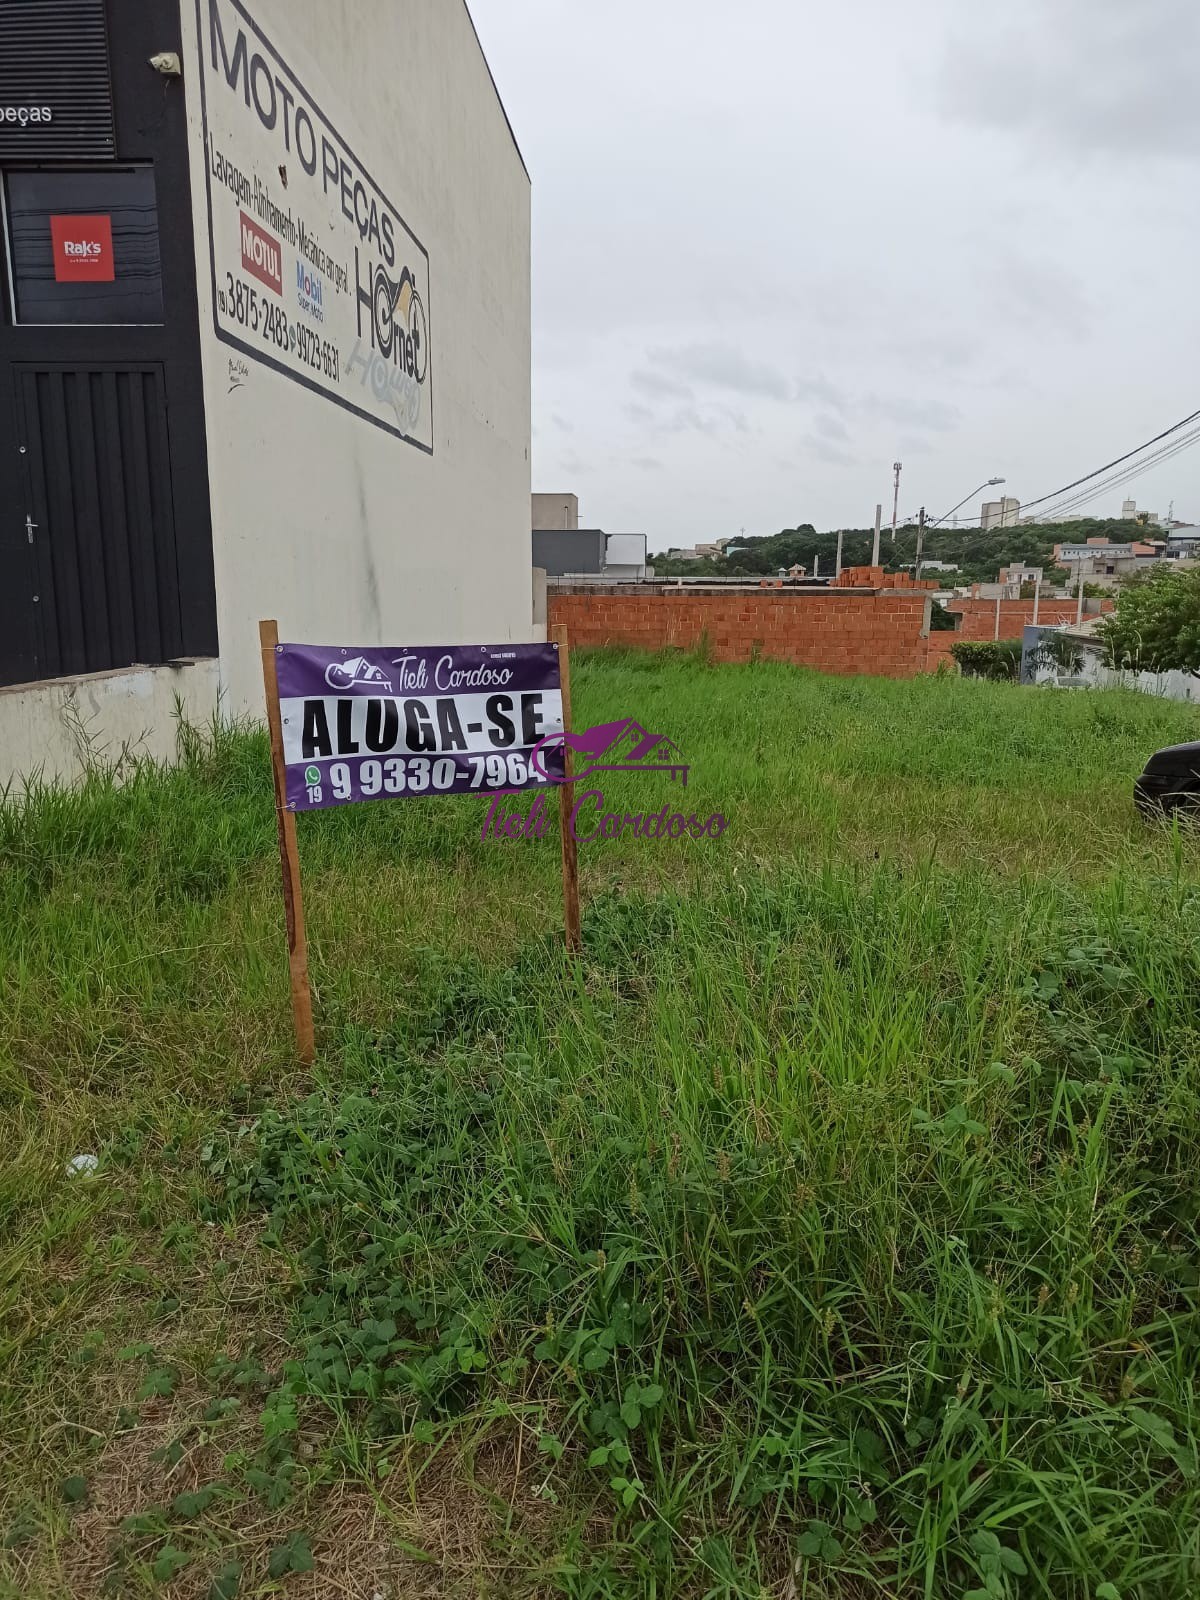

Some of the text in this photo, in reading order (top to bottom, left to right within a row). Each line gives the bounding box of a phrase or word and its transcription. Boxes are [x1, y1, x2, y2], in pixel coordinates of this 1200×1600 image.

[242, 223, 281, 282] MOTUL
[296, 260, 323, 306] Mobil
[391, 655, 514, 692] Tieli Cardoso
[302, 693, 546, 759] ALUGA-SE
[306, 785, 323, 804] 19
[329, 762, 353, 800] 9
